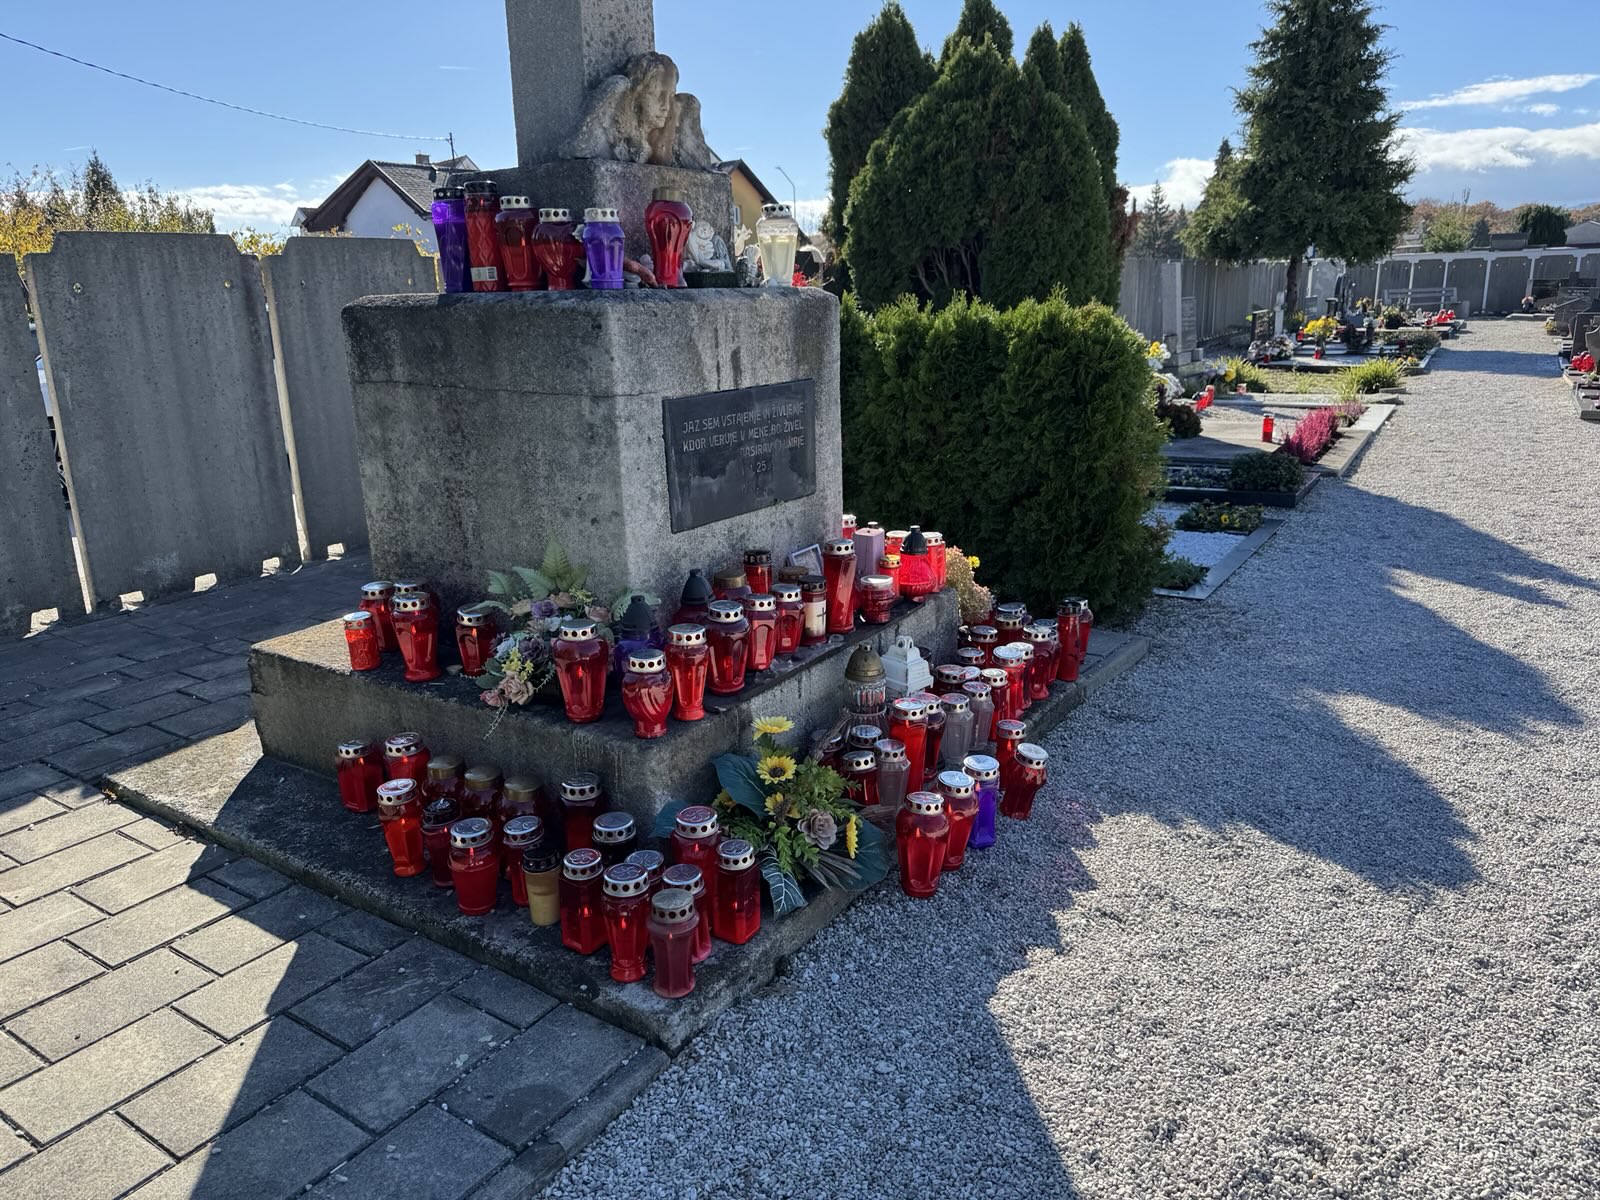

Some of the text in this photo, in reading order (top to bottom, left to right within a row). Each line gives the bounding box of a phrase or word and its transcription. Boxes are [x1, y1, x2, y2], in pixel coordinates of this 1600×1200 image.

[682, 420, 700, 434] JAZ
[702, 417, 720, 431] SEM
[683, 438, 707, 453] KDOR
[740, 429, 748, 441] V
